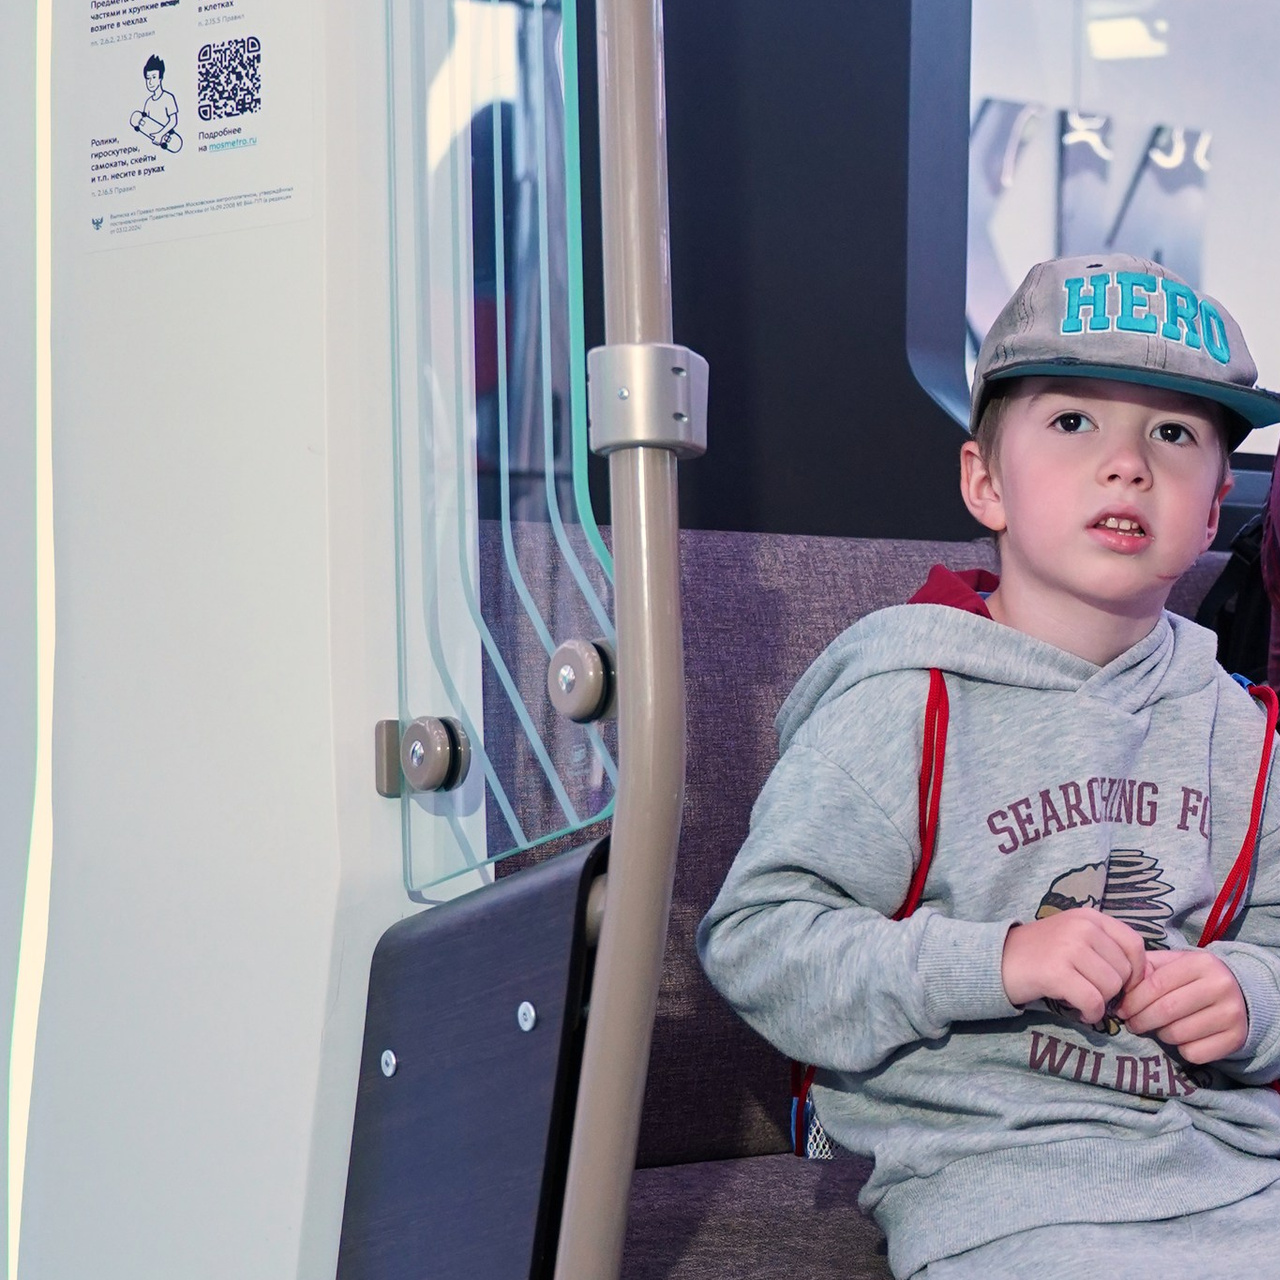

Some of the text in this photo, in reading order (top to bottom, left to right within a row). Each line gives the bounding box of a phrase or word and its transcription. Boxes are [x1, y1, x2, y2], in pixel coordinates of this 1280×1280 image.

[90, 22, 115, 33] возите
[121, 16, 147, 26] чехлах
[198, 126, 242, 140] Подробнее
[197, 137, 257, 152] на mosmetro.ru
[129, 154, 156, 165] скейты
[1060, 270, 1231, 365] HERO
